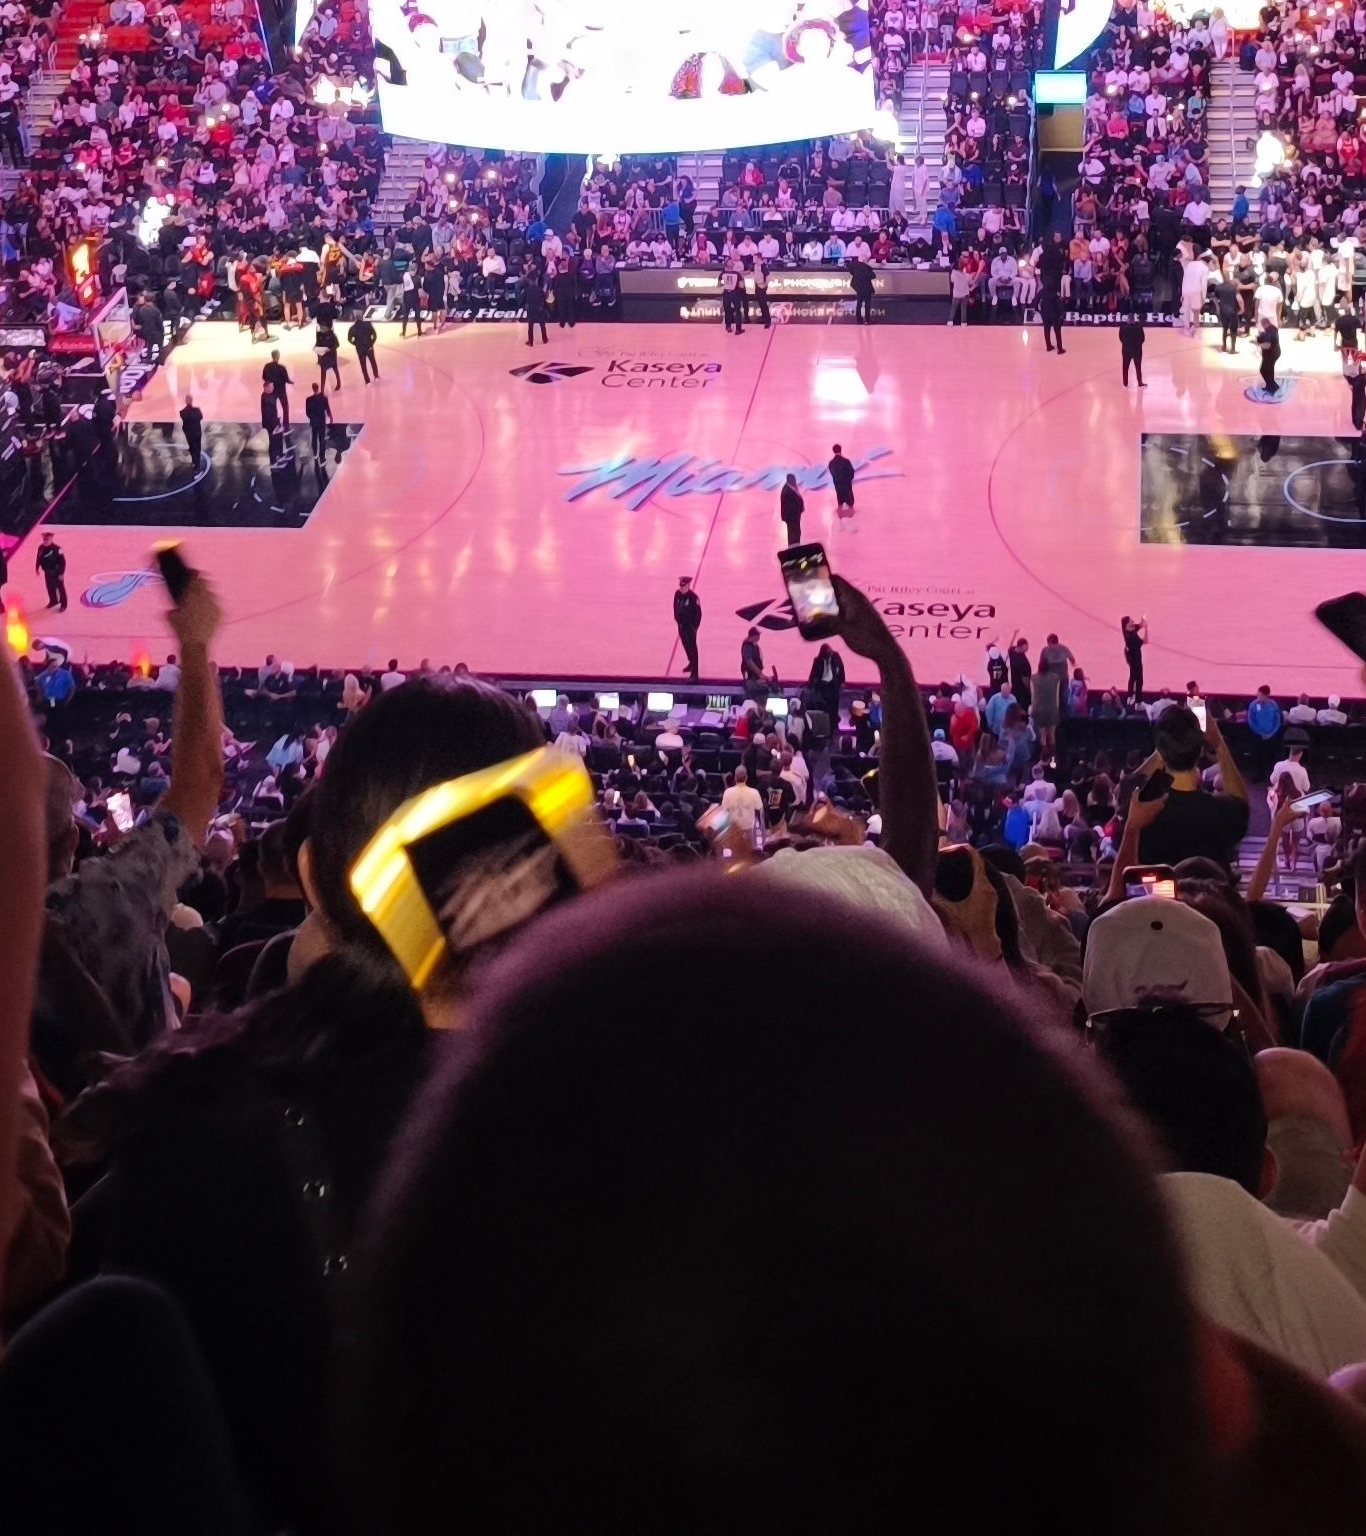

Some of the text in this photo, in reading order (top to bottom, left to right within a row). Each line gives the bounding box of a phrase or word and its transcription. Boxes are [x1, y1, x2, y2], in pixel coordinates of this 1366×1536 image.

[1065, 311, 1140, 324] Baptist
[607, 359, 723, 378] Kaseya
[600, 375, 716, 389] Center
[890, 585, 923, 596] Riley
[873, 597, 997, 623] aseya
[891, 622, 990, 640] enter
